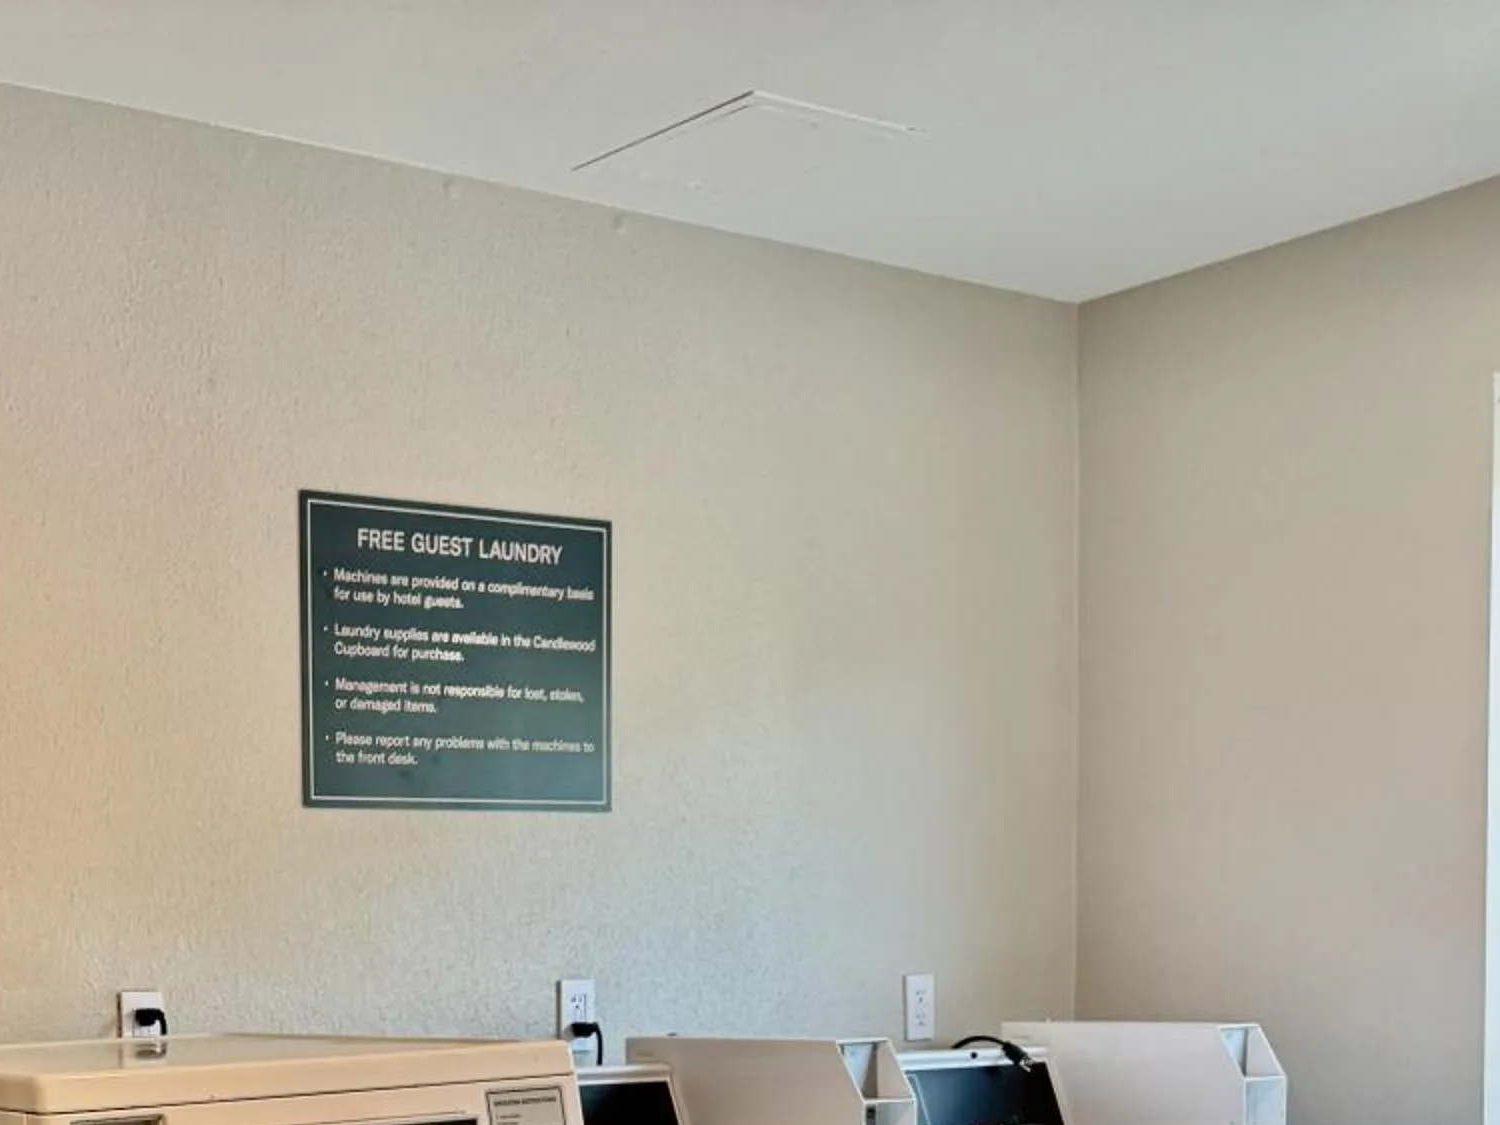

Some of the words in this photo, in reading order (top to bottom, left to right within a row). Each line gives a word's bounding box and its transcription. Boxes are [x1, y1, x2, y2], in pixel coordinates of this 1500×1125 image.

[357, 527, 405, 551] FREE
[411, 532, 473, 557] GUEST
[479, 538, 563, 565] LAUNDRY
[333, 567, 388, 585] Machines
[390, 575, 409, 586] are
[411, 575, 459, 591] provided
[461, 580, 476, 592] on
[477, 582, 485, 593] a
[487, 581, 565, 601] complimentary
[566, 585, 595, 601] basis
[333, 585, 350, 600] for
[352, 590, 374, 602] use
[376, 589, 391, 606] by
[393, 590, 421, 605] hotel
[423, 595, 464, 611] guests.
[334, 622, 381, 640] Laundry
[383, 627, 429, 642] supplies
[431, 631, 450, 642] are
[451, 631, 499, 646] available
[501, 632, 512, 647] in
[513, 634, 531, 648] the
[533, 635, 596, 652] Candlewood
[334, 641, 390, 658] Cupboard
[392, 644, 410, 658] for
[411, 647, 465, 662] purchase.
[335, 677, 408, 695] Management
[409, 681, 420, 695] is
[422, 683, 442, 696] not
[443, 684, 506, 699] responsible
[507, 684, 522, 699] for
[523, 685, 548, 701] lost,
[549, 688, 585, 704] stolen,
[334, 698, 348, 710] or
[349, 697, 402, 715] damaged
[403, 700, 437, 714] items.
[335, 731, 373, 746] Please
[375, 736, 410, 749] report
[411, 738, 433, 751] any
[434, 735, 485, 751] problems
[486, 736, 511, 751] with
[511, 738, 531, 752] the
[531, 739, 582, 753] machines
[583, 740, 596, 753] to
[335, 750, 356, 764] the
[357, 750, 386, 764] front
[387, 752, 419, 766] desk.
